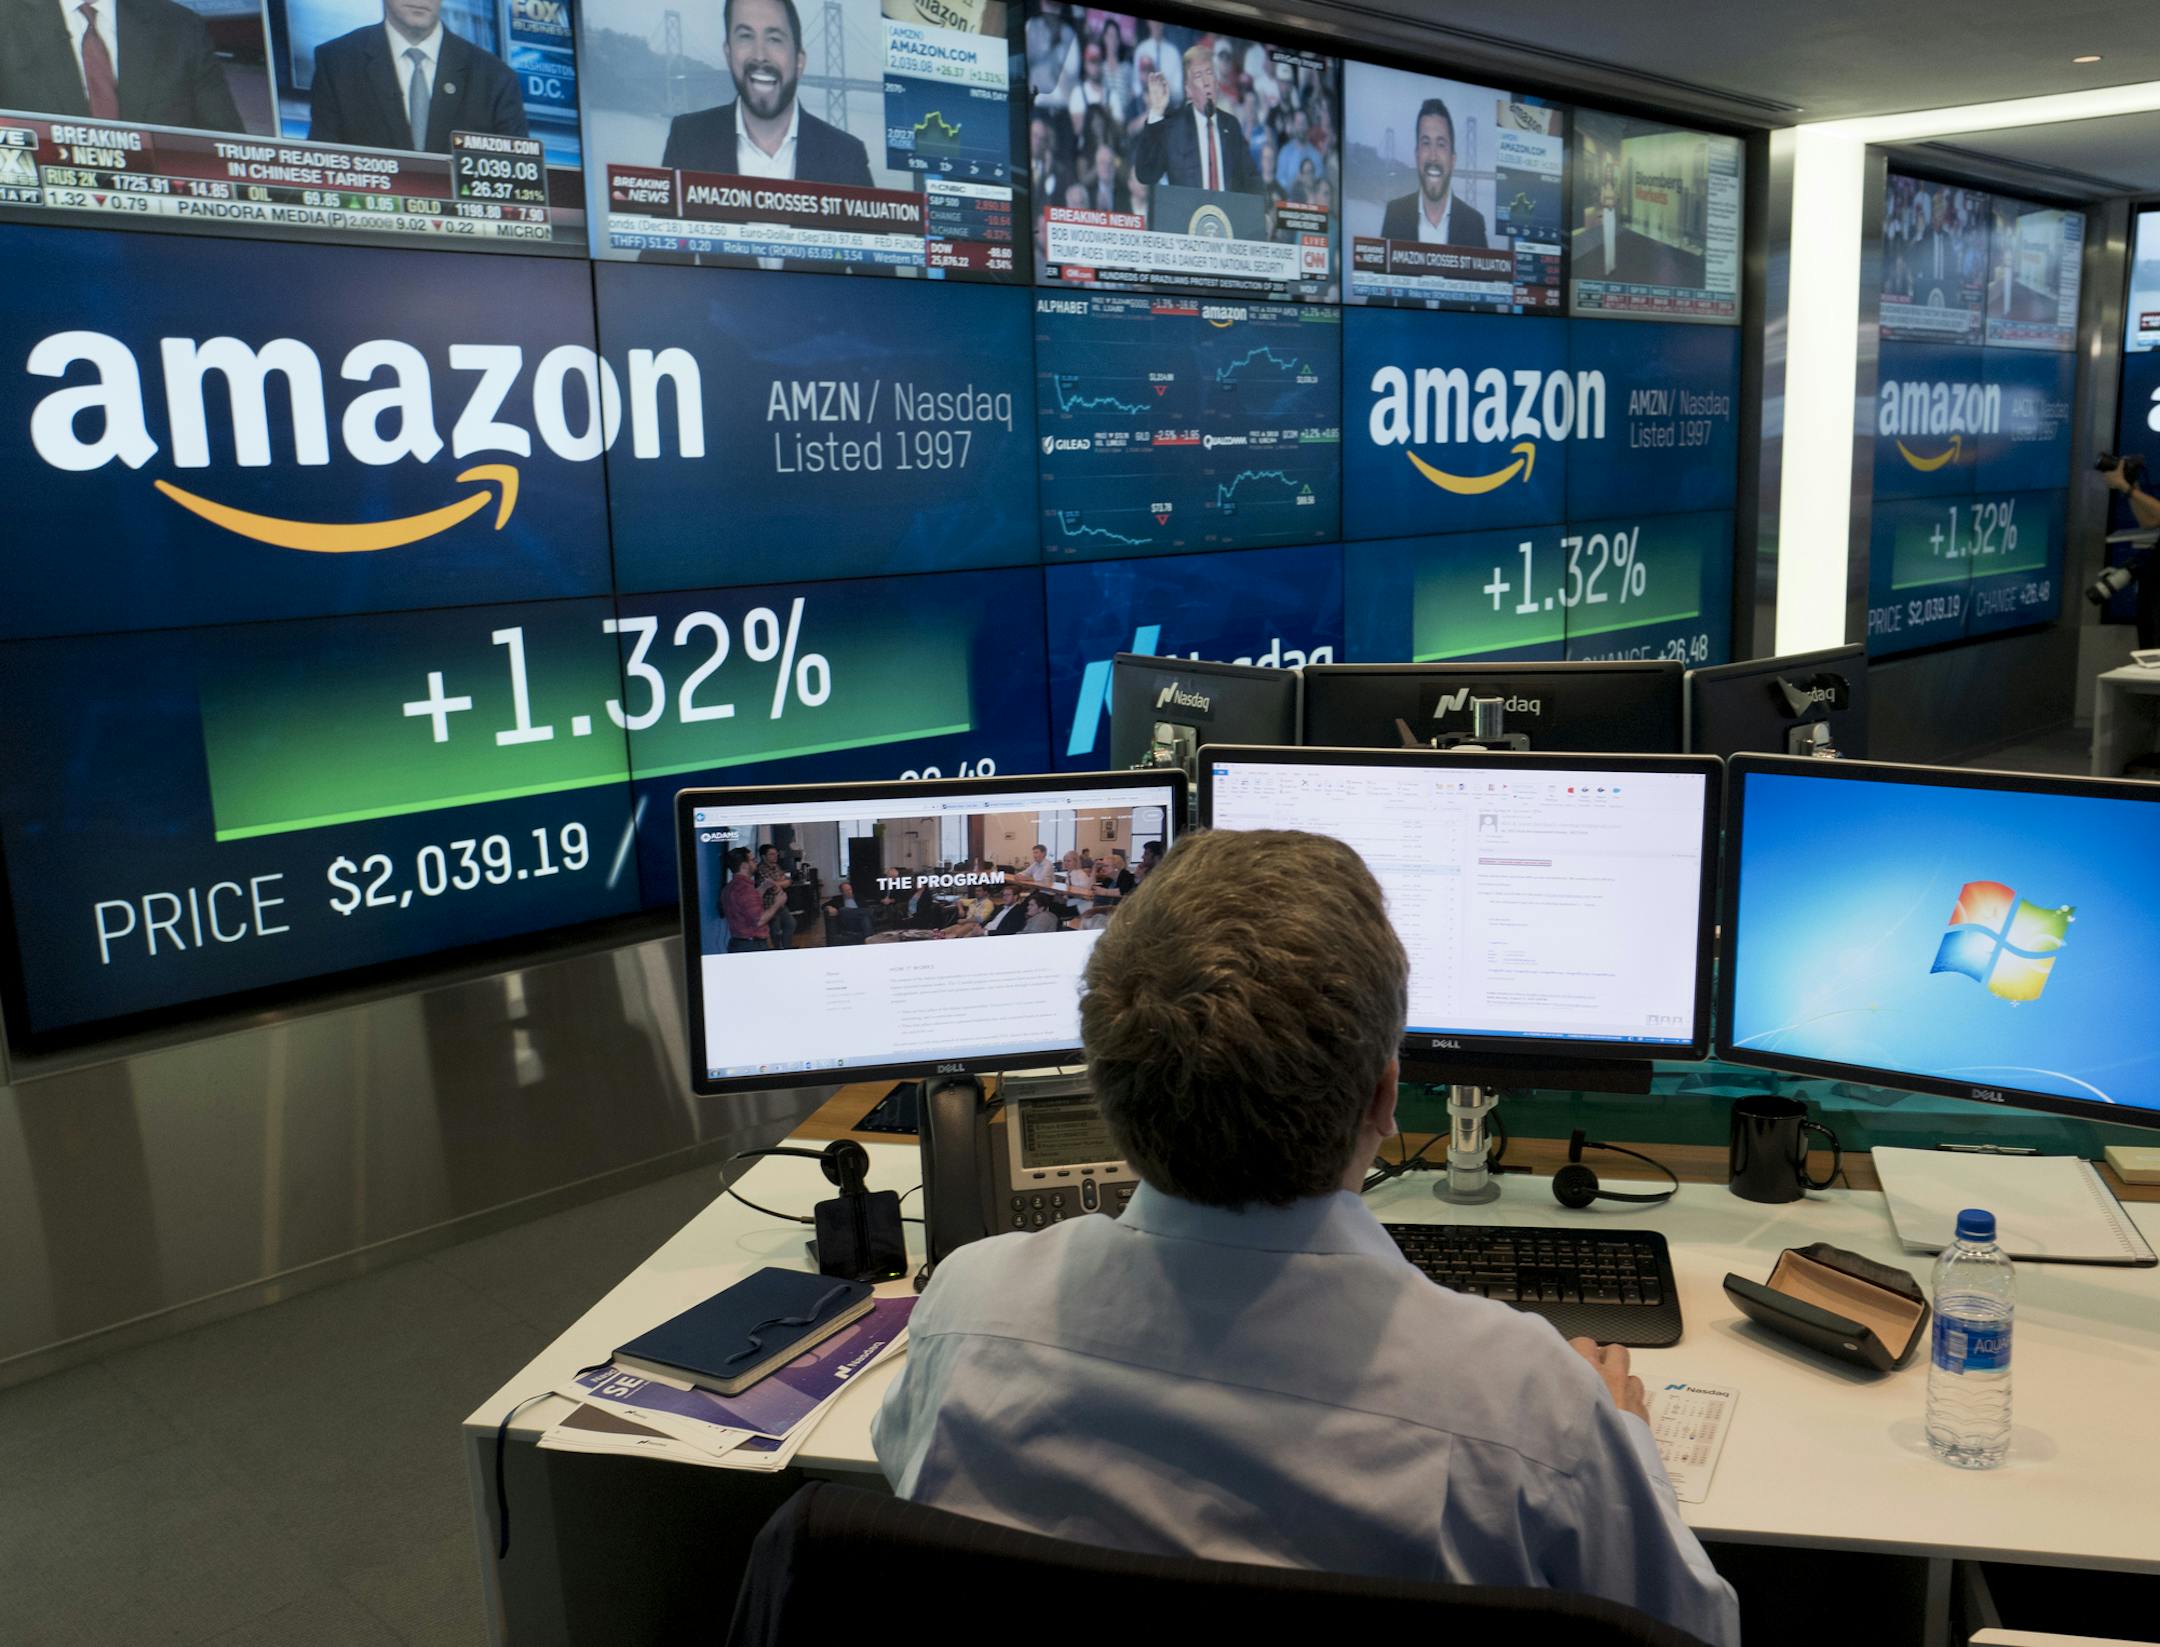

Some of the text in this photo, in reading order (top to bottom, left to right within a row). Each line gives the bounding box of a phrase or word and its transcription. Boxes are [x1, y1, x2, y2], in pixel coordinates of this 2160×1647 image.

[513, 0, 558, 23] FOX
[890, 40, 977, 63] AMAZON.COM
[890, 55, 933, 72] 2,039.08
[528, 75, 565, 99] D.C.
[51, 124, 141, 151] BREAKING
[464, 134, 540, 155] AMAZON.COM
[72, 145, 127, 169] NEWS
[214, 143, 399, 174] TRUMP READIES $200B
[460, 157, 538, 180] 2,039.08
[228, 162, 391, 190] IN CHINESE TARIFFS
[613, 176, 670, 190] BREAKING
[46, 168, 77, 186] RUS
[78, 171, 99, 187] 2K
[112, 175, 170, 194] 1725.91
[188, 182, 229, 198] 14.85
[248, 186, 272, 201] OIL
[303, 191, 340, 207] 69.85
[406, 200, 442, 215] GOLD
[518, 208, 544, 222] 7.90
[471, 181, 545, 202] 26.37 1.31%
[628, 189, 670, 204] NEWS
[50, 191, 88, 207] 1.32
[111, 196, 148, 212] 0.79
[178, 200, 267, 220] PANDORA
[272, 205, 325, 224] MEDIA
[327, 210, 348, 229] (P)
[396, 218, 426, 231] 9.02
[446, 221, 475, 234] 0.22
[687, 185, 752, 207] AMAZON
[754, 190, 818, 213] CROSSES
[845, 199, 919, 222] VALUATION
[1050, 207, 1141, 228] BREAKING NEWS
[689, 240, 711, 252] 0.20
[723, 242, 749, 254] Roku
[843, 249, 863, 261] 3.54
[873, 252, 910, 264] Western
[874, 237, 892, 246] FED
[931, 243, 953, 254] DOW
[1051, 227, 1068, 240] BOB
[1070, 228, 1117, 245] WOODWARD
[1120, 233, 1140, 247] BOOK
[1143, 235, 1174, 250] REVEALS
[1227, 244, 1248, 256] INSIDE
[1250, 246, 1269, 258] WHITE
[1272, 247, 1293, 260] HOUSE
[1052, 244, 1079, 257] TRUMP
[1082, 247, 1103, 260] AIDES
[1106, 249, 1140, 263] WORRIED
[1143, 252, 1152, 263] HE
[1155, 252, 1170, 265] WAS
[1179, 254, 1206, 267] DANGER
[1208, 257, 1217, 269] TO
[1220, 258, 1251, 271] NATIONAL
[1254, 261, 1284, 274] SECURITY
[1304, 251, 1326, 268] CNN
[1392, 250, 1425, 265] AMAZON
[1426, 252, 1459, 268] CROSSES
[1472, 256, 1511, 272] VALUATION
[1099, 271, 1138, 281] HUNDREDS
[1036, 299, 1089, 315] ALPHABET
[1202, 306, 1247, 320] amazon
[27, 330, 706, 472] amazon
[894, 382, 1013, 432] Nasdaq
[1369, 365, 1606, 447] amazon
[1679, 389, 1730, 422] Nasdaq
[1879, 380, 2001, 436] amazon
[1055, 439, 1091, 450] GILEAD
[1630, 420, 1712, 448] Listed 1997
[775, 430, 972, 473] Listed 1997
[1929, 498, 2017, 559] +1.32%
[1483, 526, 1646, 614] +1.32%
[1868, 580, 2050, 636] PRICE $2,039.19 CHANGE +26.48
[403, 597, 832, 747] +1.32%
[1174, 689, 1210, 712] Nasdaq
[711, 831, 740, 840] ADAMS
[876, 871, 1005, 891] THE PROGRAM
[95, 822, 590, 964] PRICE $2,039.19
[1432, 1038, 1461, 1050] DELL
[937, 1063, 965, 1074] DELL
[1971, 1088, 2005, 1103] DELL
[1687, 1386, 1729, 1398] Nasdaq
